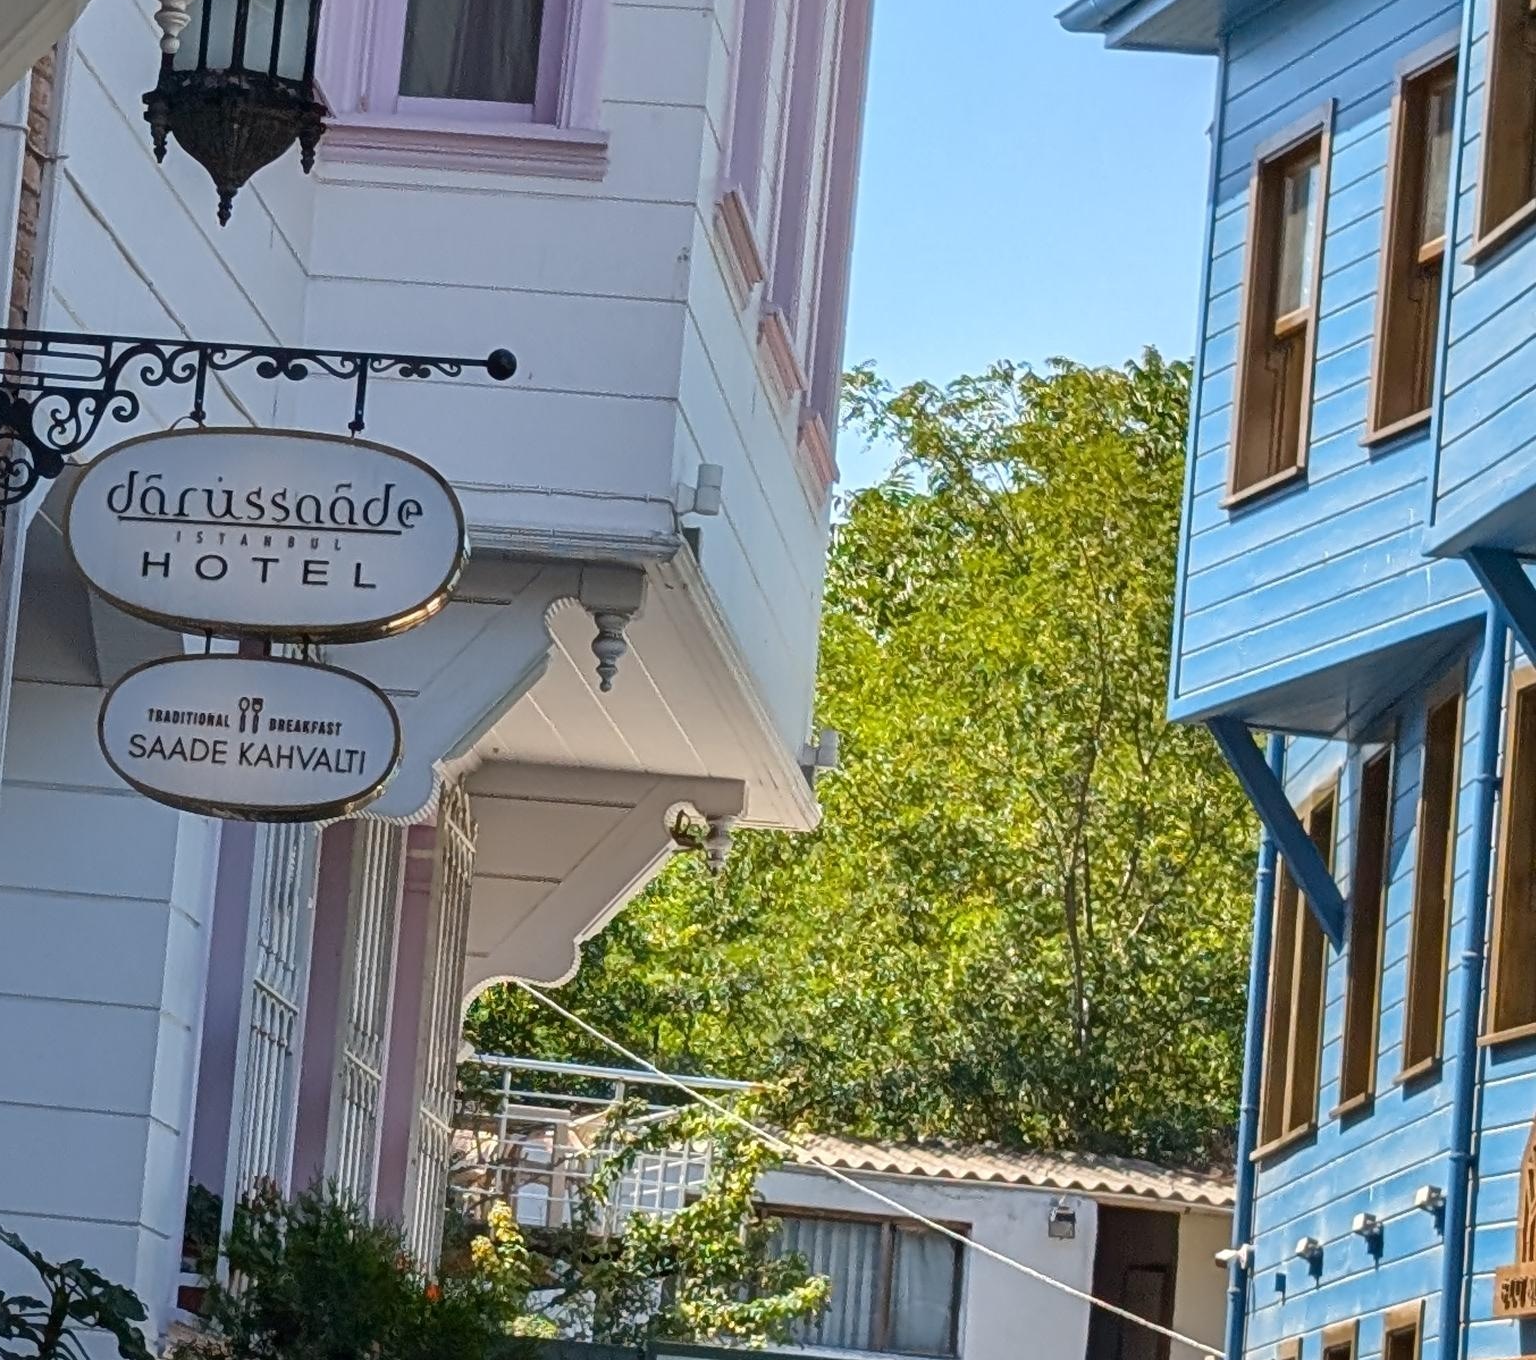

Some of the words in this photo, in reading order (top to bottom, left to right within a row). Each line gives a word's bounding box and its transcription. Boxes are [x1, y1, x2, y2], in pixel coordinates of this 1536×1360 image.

[141, 550, 377, 589] HOTEL
[148, 708, 231, 728] TRADITIONAL
[268, 717, 343, 737] BREAKFAST
[128, 733, 229, 765] SAADE
[238, 742, 367, 775] KAHVALTI
